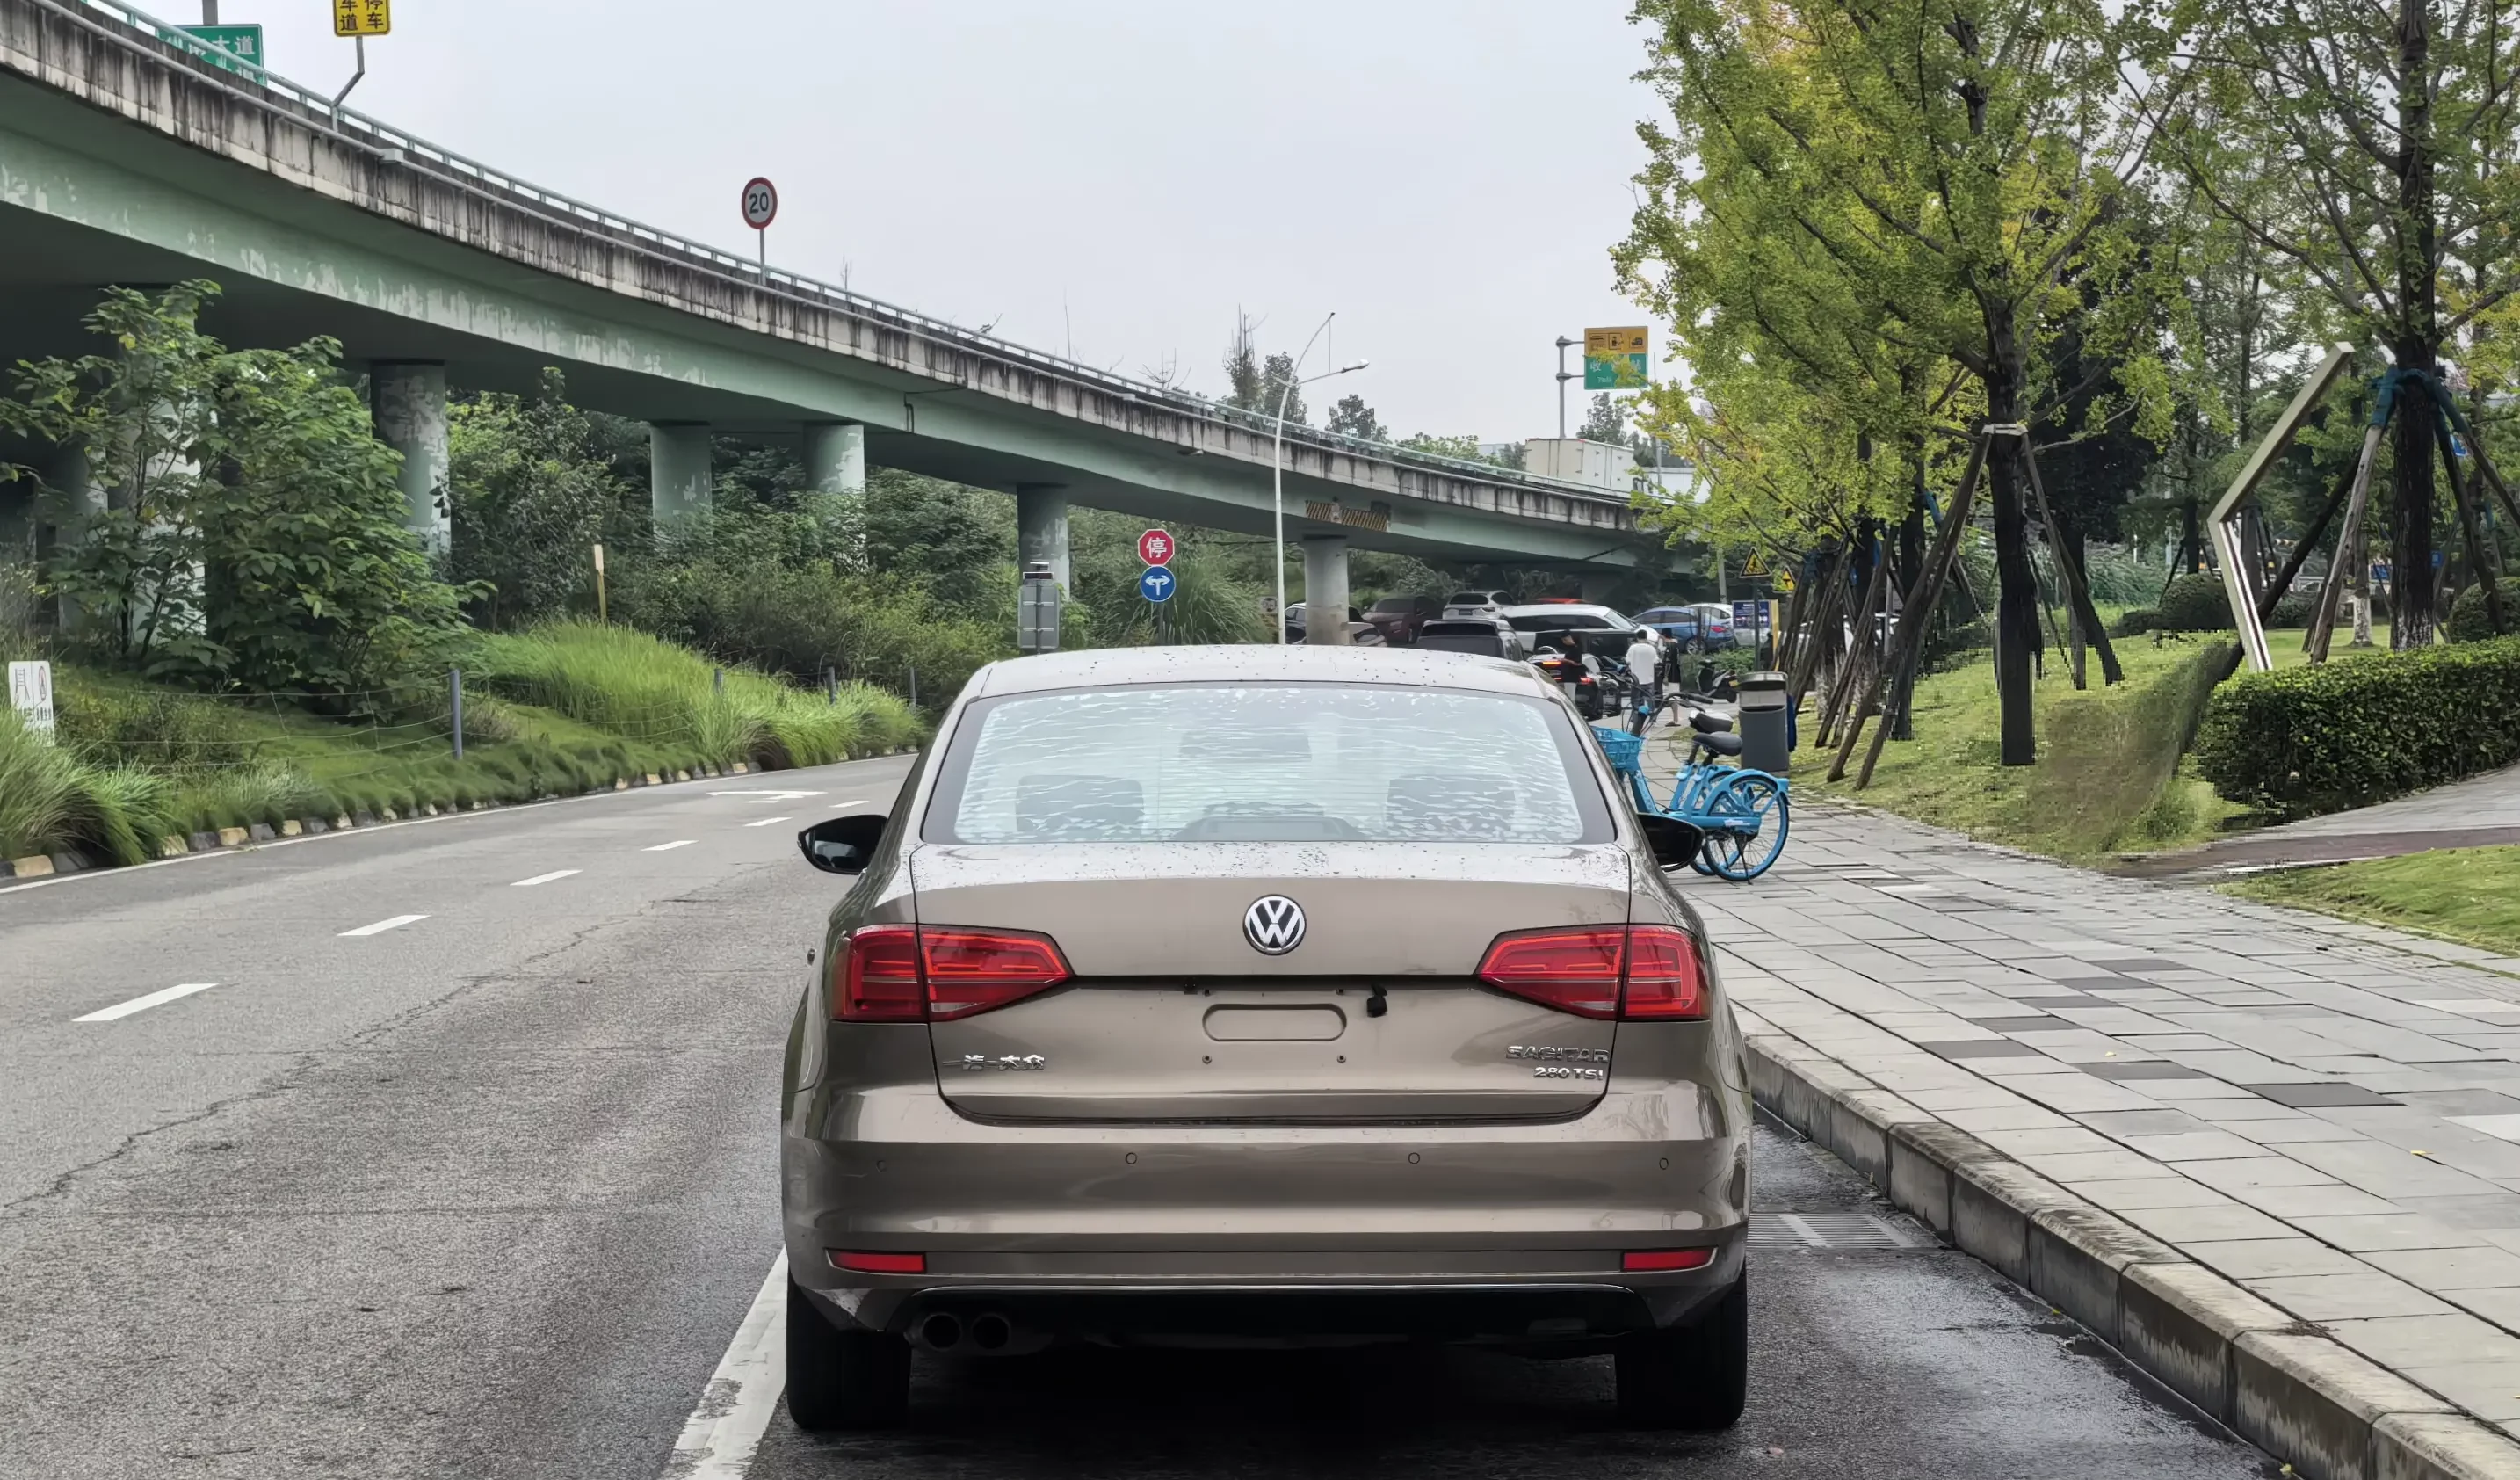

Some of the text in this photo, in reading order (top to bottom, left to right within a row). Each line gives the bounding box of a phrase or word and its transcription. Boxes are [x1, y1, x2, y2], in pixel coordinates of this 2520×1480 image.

[749, 192, 770, 214] 20
[1146, 537, 1167, 559] 停
[1506, 1045, 1610, 1063] SAGITAR
